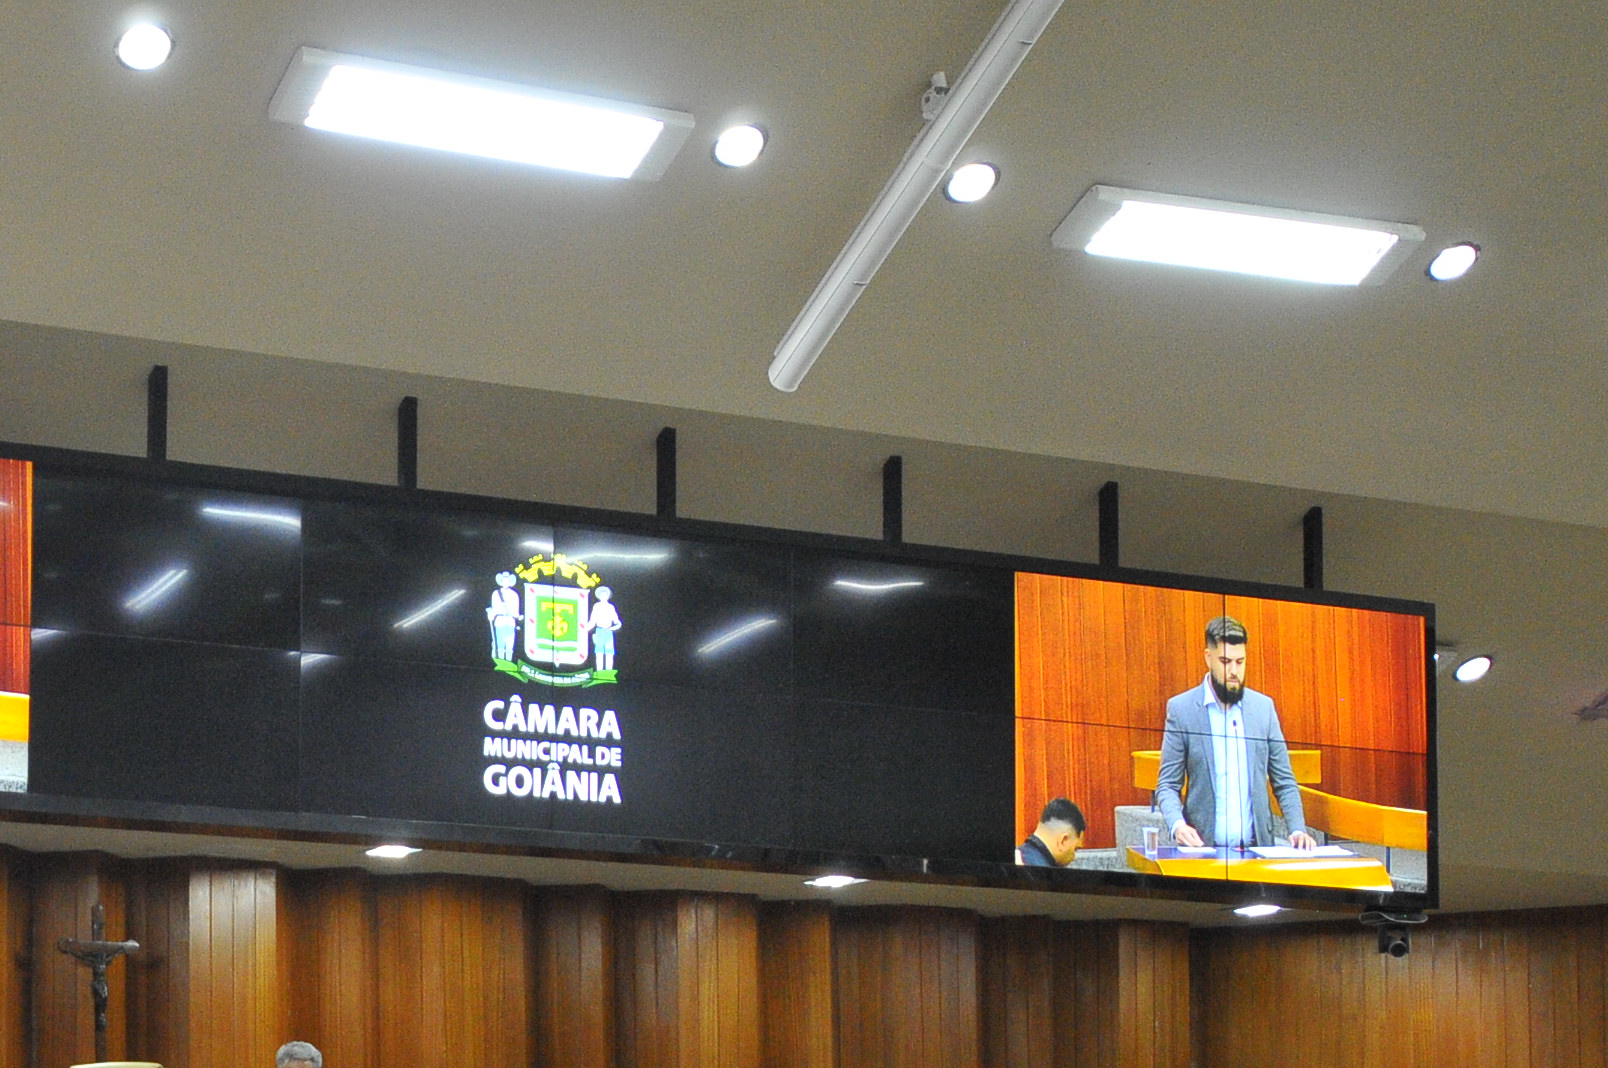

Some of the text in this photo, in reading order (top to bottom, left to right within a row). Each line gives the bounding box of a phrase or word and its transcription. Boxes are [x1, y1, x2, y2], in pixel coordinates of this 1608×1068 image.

[483, 694, 622, 740] CÂMARA
[483, 736, 622, 768] MUNICIPAL DE
[483, 762, 622, 804] GOIÂNIA
